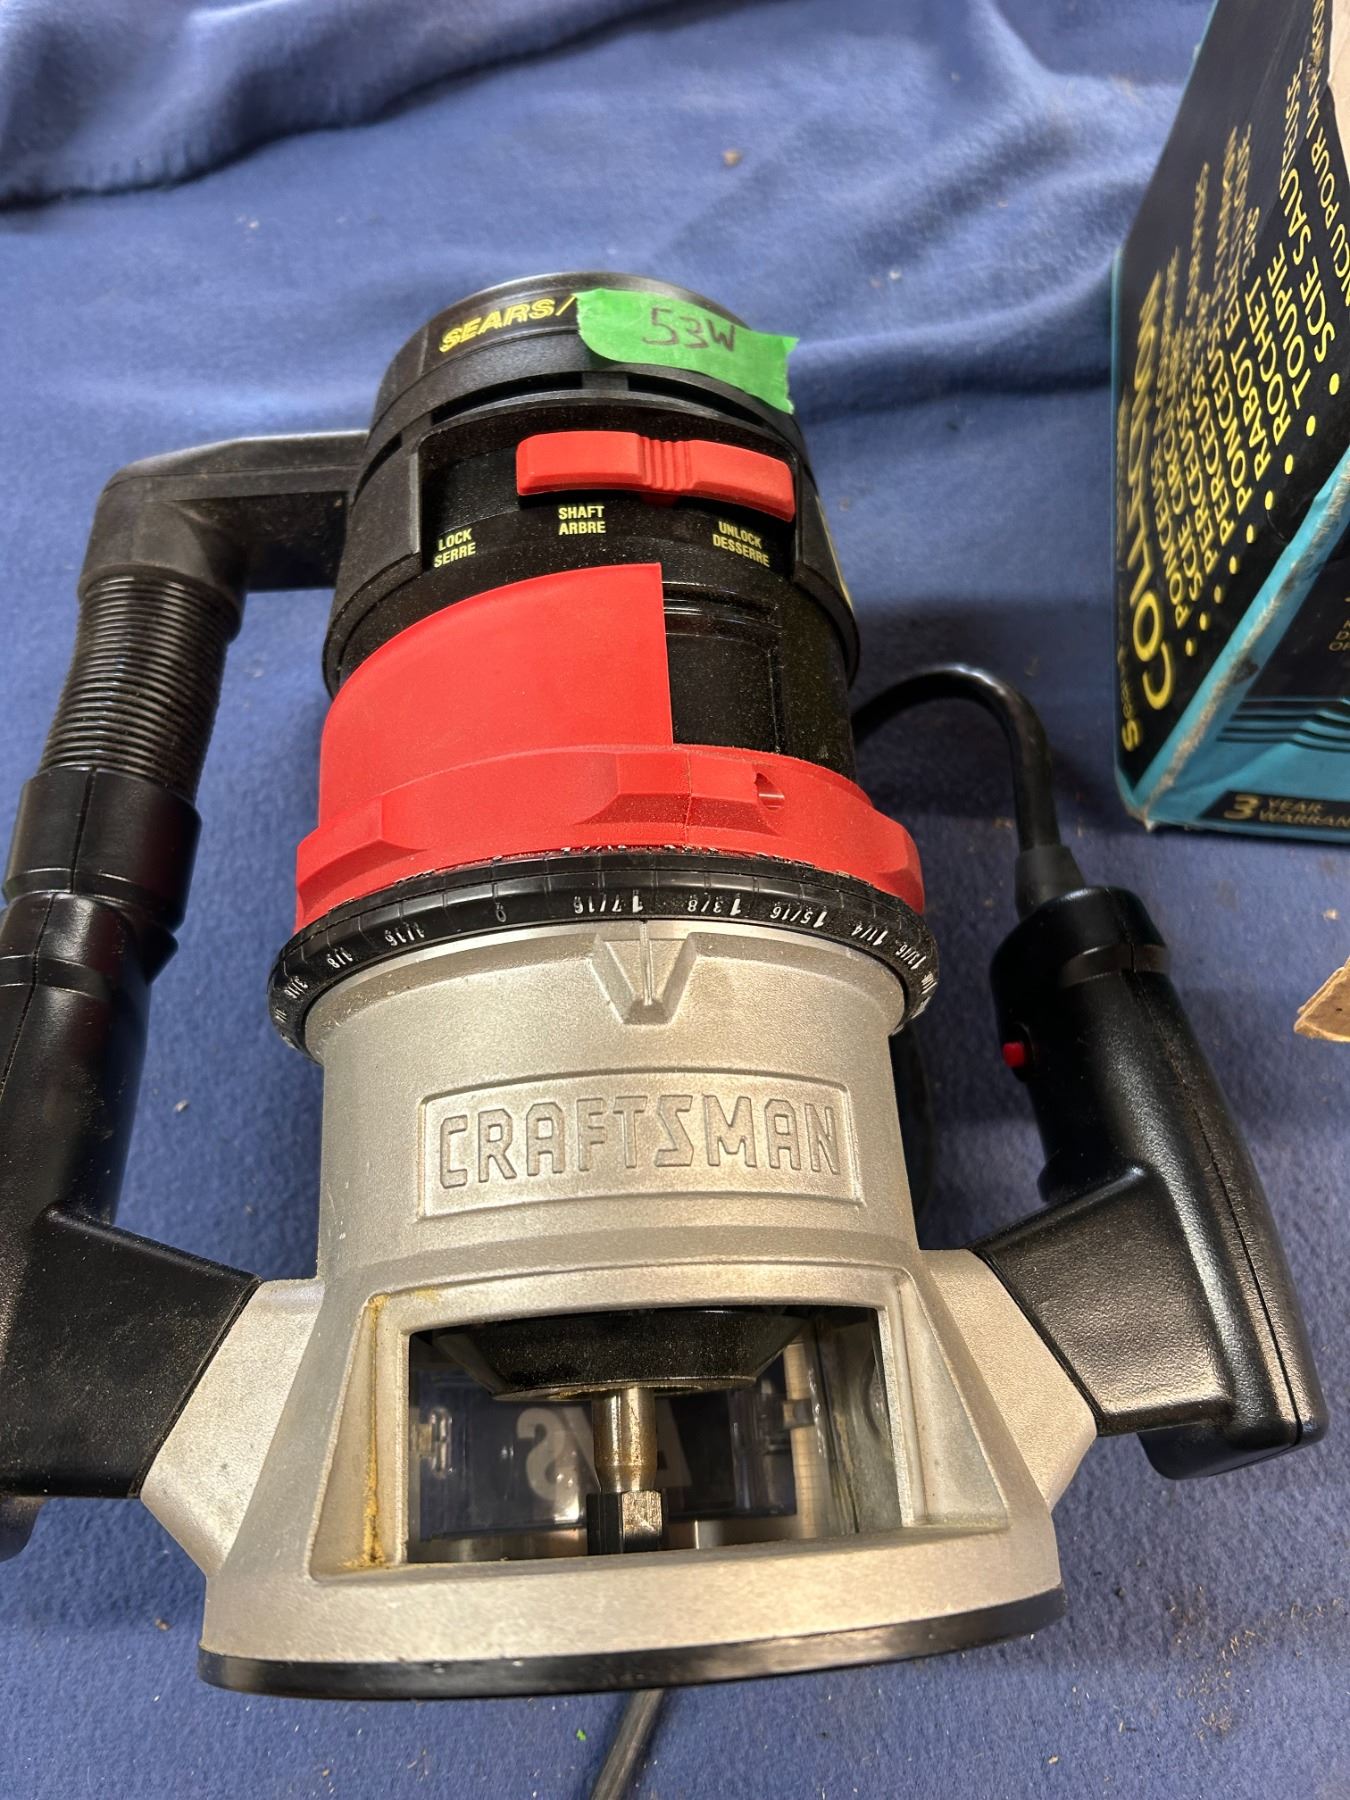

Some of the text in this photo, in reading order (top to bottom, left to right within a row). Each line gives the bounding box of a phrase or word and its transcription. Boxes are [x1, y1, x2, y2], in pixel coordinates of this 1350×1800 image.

[1306, 83, 1321, 139] LA
[1280, 58, 1336, 363] SCIE SAUTEUSE
[1312, 127, 1339, 230] POUR
[1245, 276, 1292, 446] ROCHET
[1267, 242, 1311, 410] TOUPIE
[1192, 353, 1235, 547] PERCEUSE
[1207, 305, 1252, 515] PONCEUSE
[1231, 337, 1273, 482] RABOT
[558, 505, 605, 520] SHAFT
[558, 520, 606, 536] ARBRE
[1127, 268, 1174, 711] COLLECTION
[1177, 387, 1219, 575] PERCEUSE
[433, 542, 476, 569] SERRE
[438, 528, 472, 552] LOCK
[712, 534, 771, 568] DESSERRE
[718, 520, 763, 550] UNLOCK
[1151, 439, 1190, 630] PONCEUSE
[1178, 514, 1204, 602] SCIE
[1224, 793, 1260, 820] 3
[1268, 798, 1323, 814] YEAR
[439, 1094, 841, 1190] CRAFTSMAN
